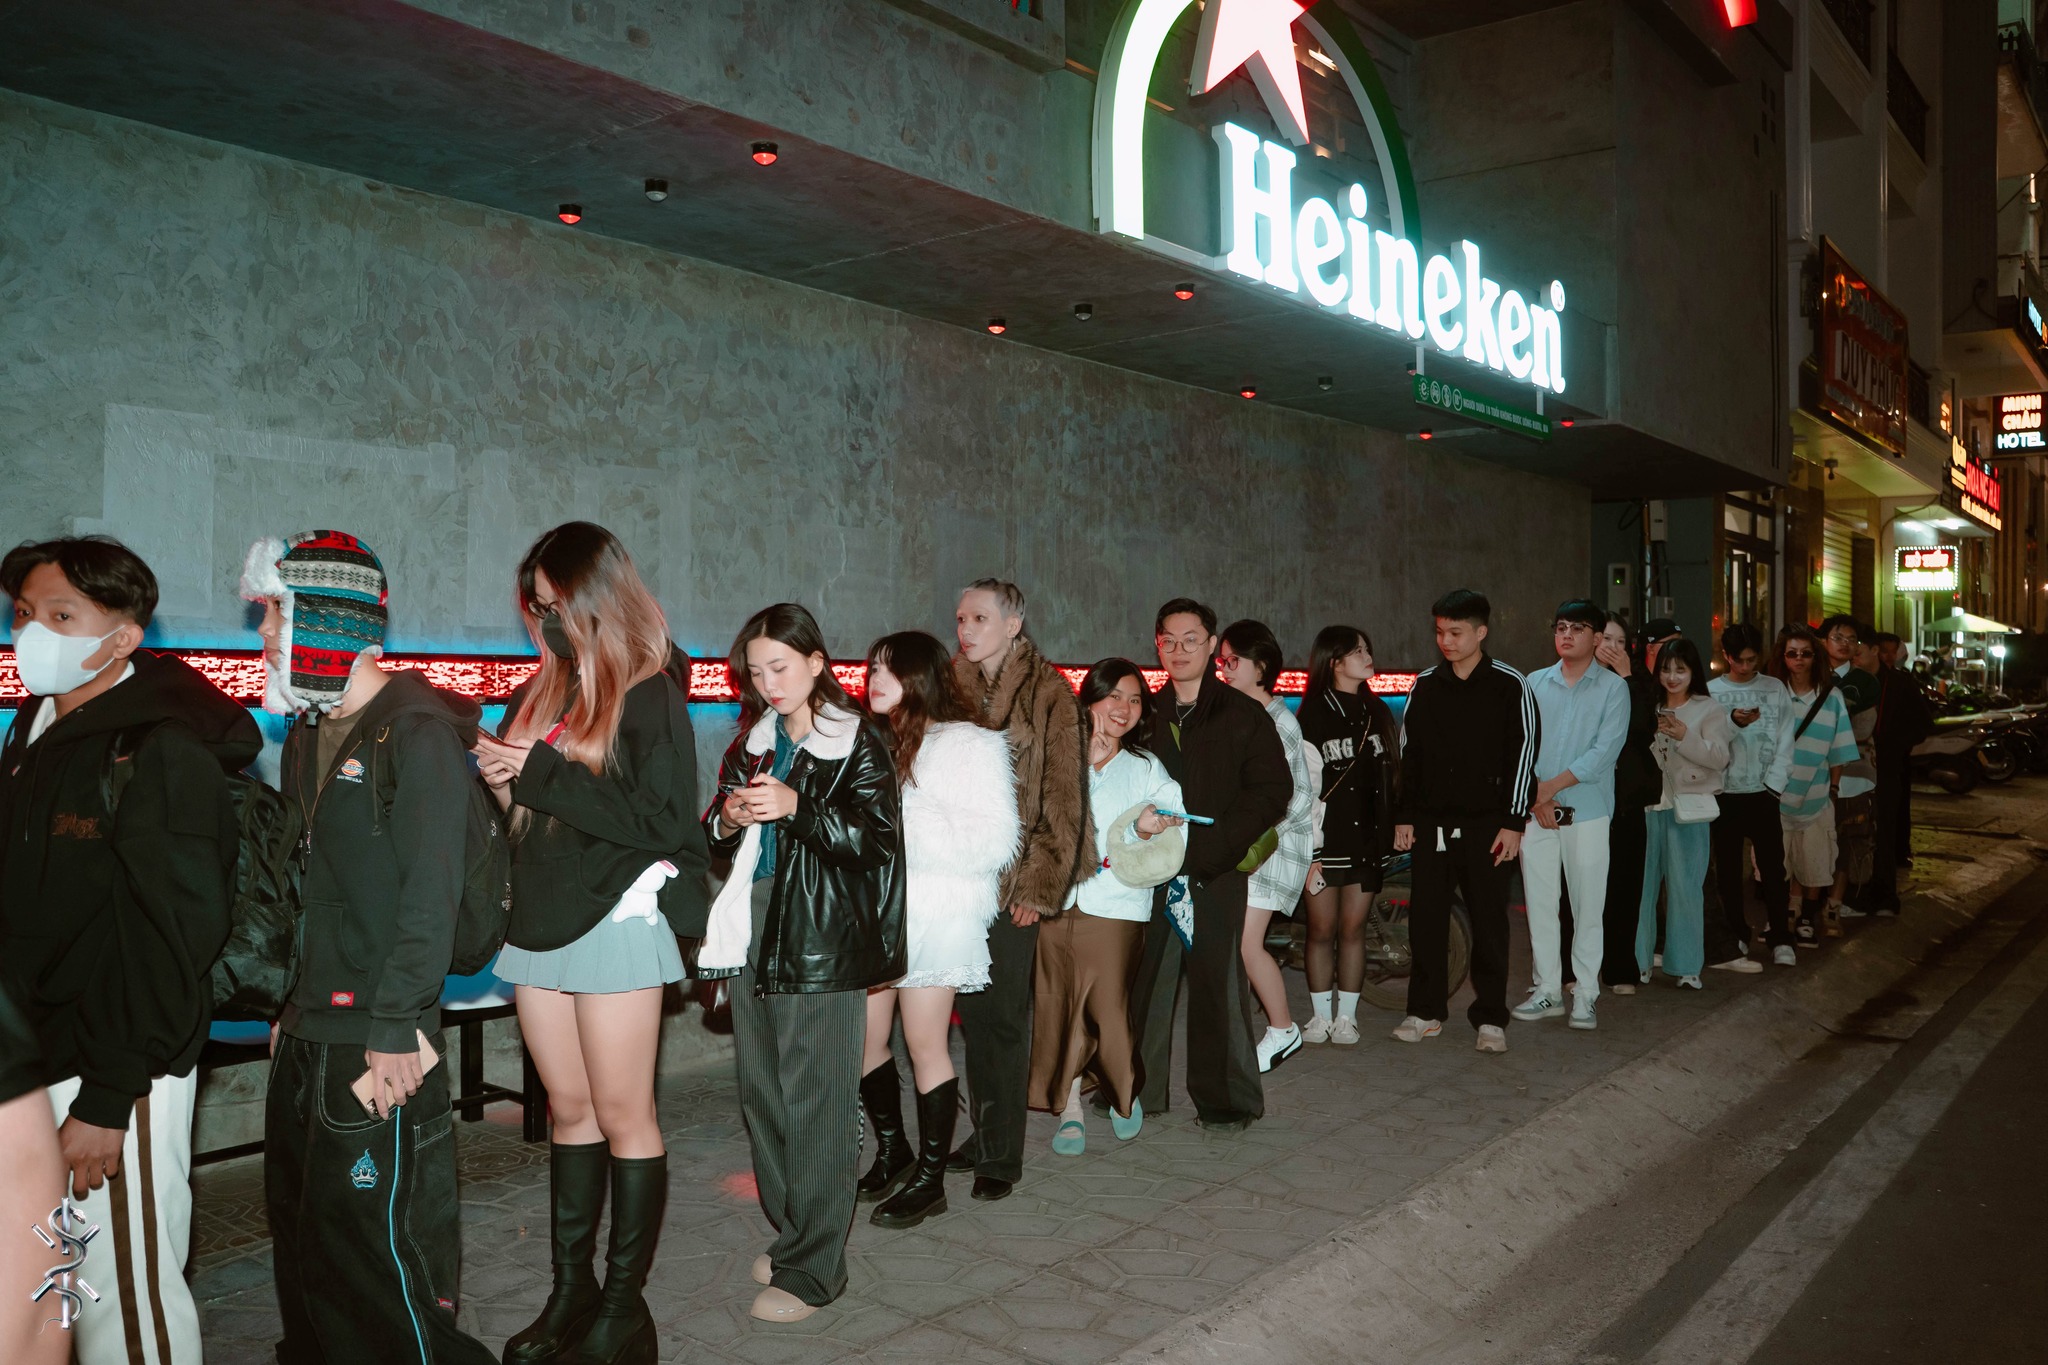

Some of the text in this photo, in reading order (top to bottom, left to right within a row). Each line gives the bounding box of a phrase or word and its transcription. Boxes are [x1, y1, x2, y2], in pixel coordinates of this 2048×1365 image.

[1223, 121, 1566, 394] Heineken
[1836, 329, 1869, 398] DUY
[2002, 394, 2041, 412] MINH
[2002, 410, 2041, 430] CHÂU
[1997, 431, 2046, 449] HOTEL
